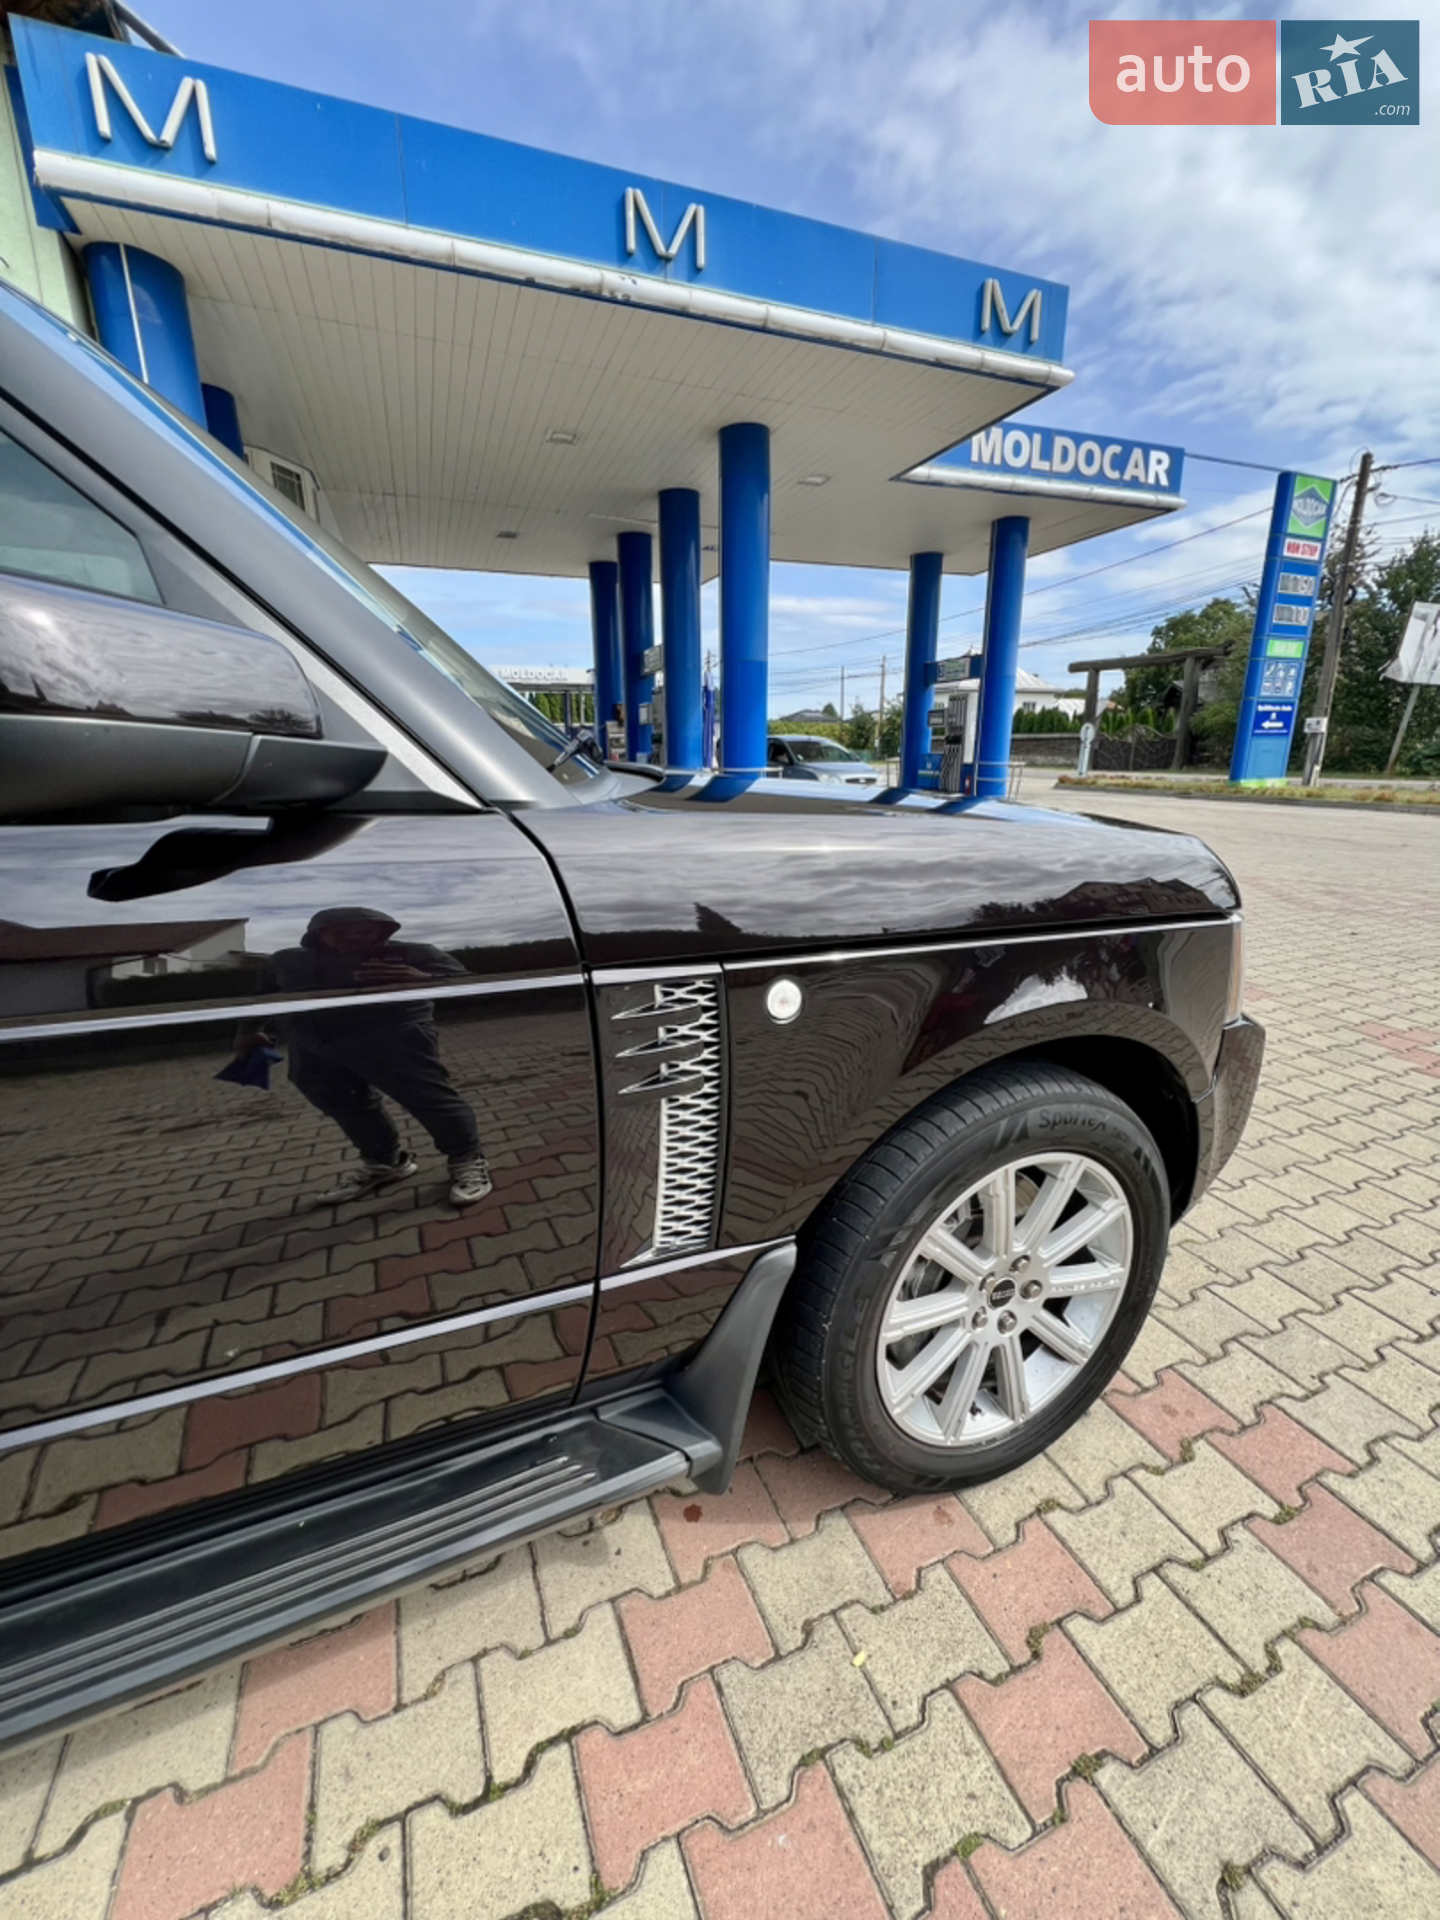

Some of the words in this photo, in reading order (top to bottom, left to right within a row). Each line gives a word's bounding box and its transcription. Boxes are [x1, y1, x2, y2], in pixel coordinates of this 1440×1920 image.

[85, 52, 217, 163] M
[624, 186, 705, 270] M
[981, 277, 1042, 342] M
[970, 425, 1171, 487] MOLDOCAR
